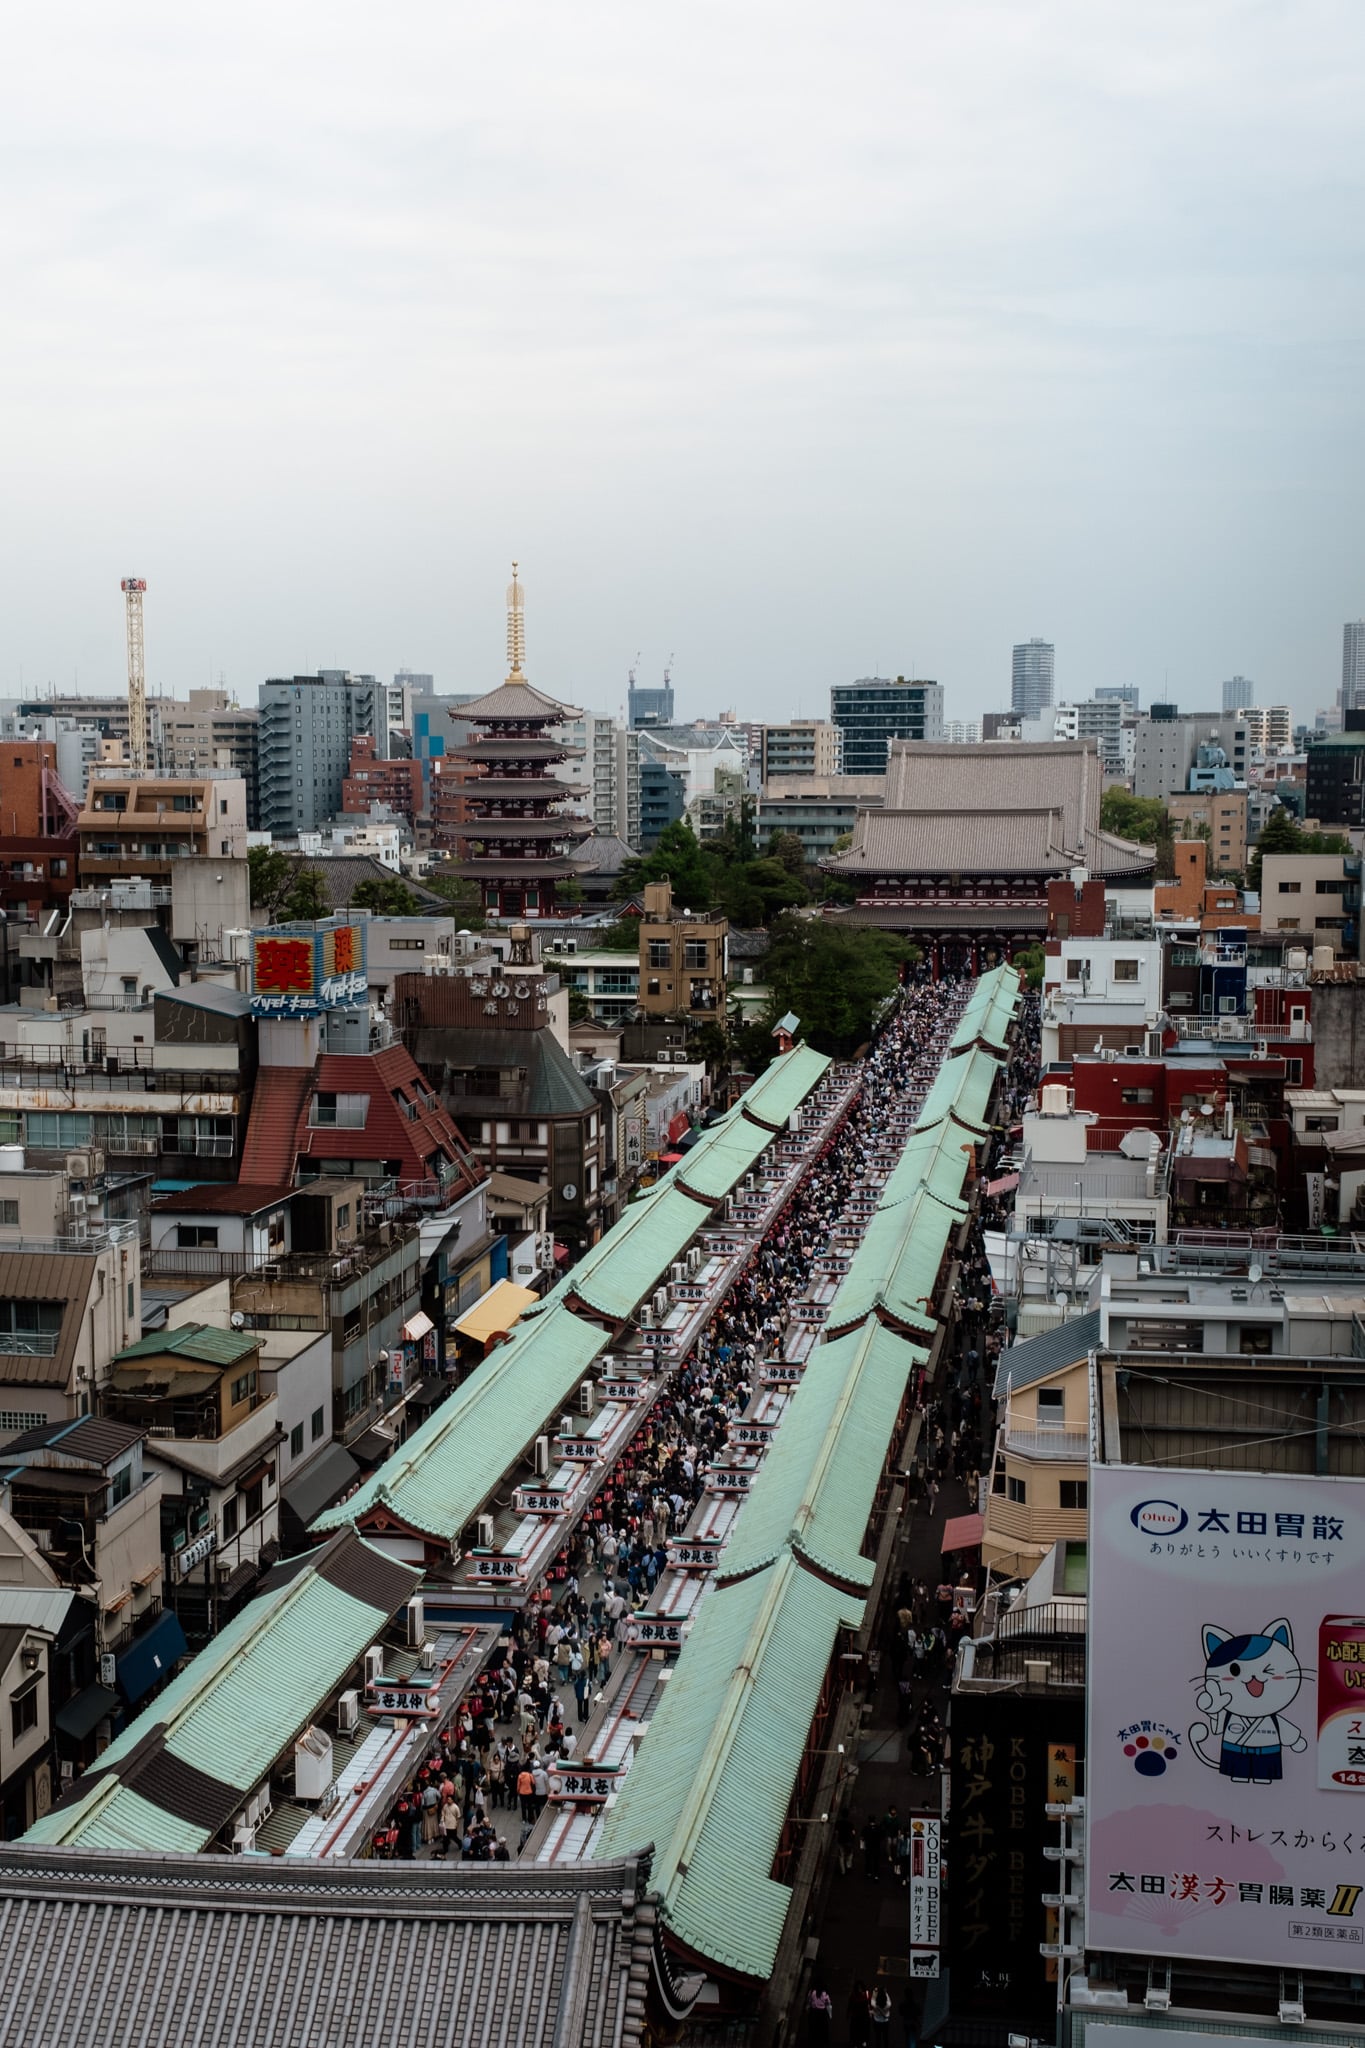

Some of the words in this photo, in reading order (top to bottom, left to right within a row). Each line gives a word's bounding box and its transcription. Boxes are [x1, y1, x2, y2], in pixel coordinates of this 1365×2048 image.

[256, 940, 312, 991] 薬
[334, 926, 352, 974] 薬
[250, 995, 319, 1012] マツモトキヨシ
[469, 980, 530, 999] 釜めし
[394, 1353, 402, 1379] コーヒー
[1198, 1508, 1344, 1541] 太田胃散
[1150, 1542, 1221, 1559] ありがとう
[1233, 1548, 1335, 1564] いいくすりです
[1118, 1720, 1181, 1745] 太田胃にゃん
[1009, 1736, 1025, 1830] KOBE
[927, 1822, 939, 1879] KOBE
[959, 1733, 997, 1952] 神戸牛ダイア
[1206, 1825, 1365, 1854] ストレスからく
[1009, 1849, 1025, 1942] BEEF
[927, 1886, 939, 1942] BEEF
[1292, 1924, 1360, 1942] 第2類医薬品
